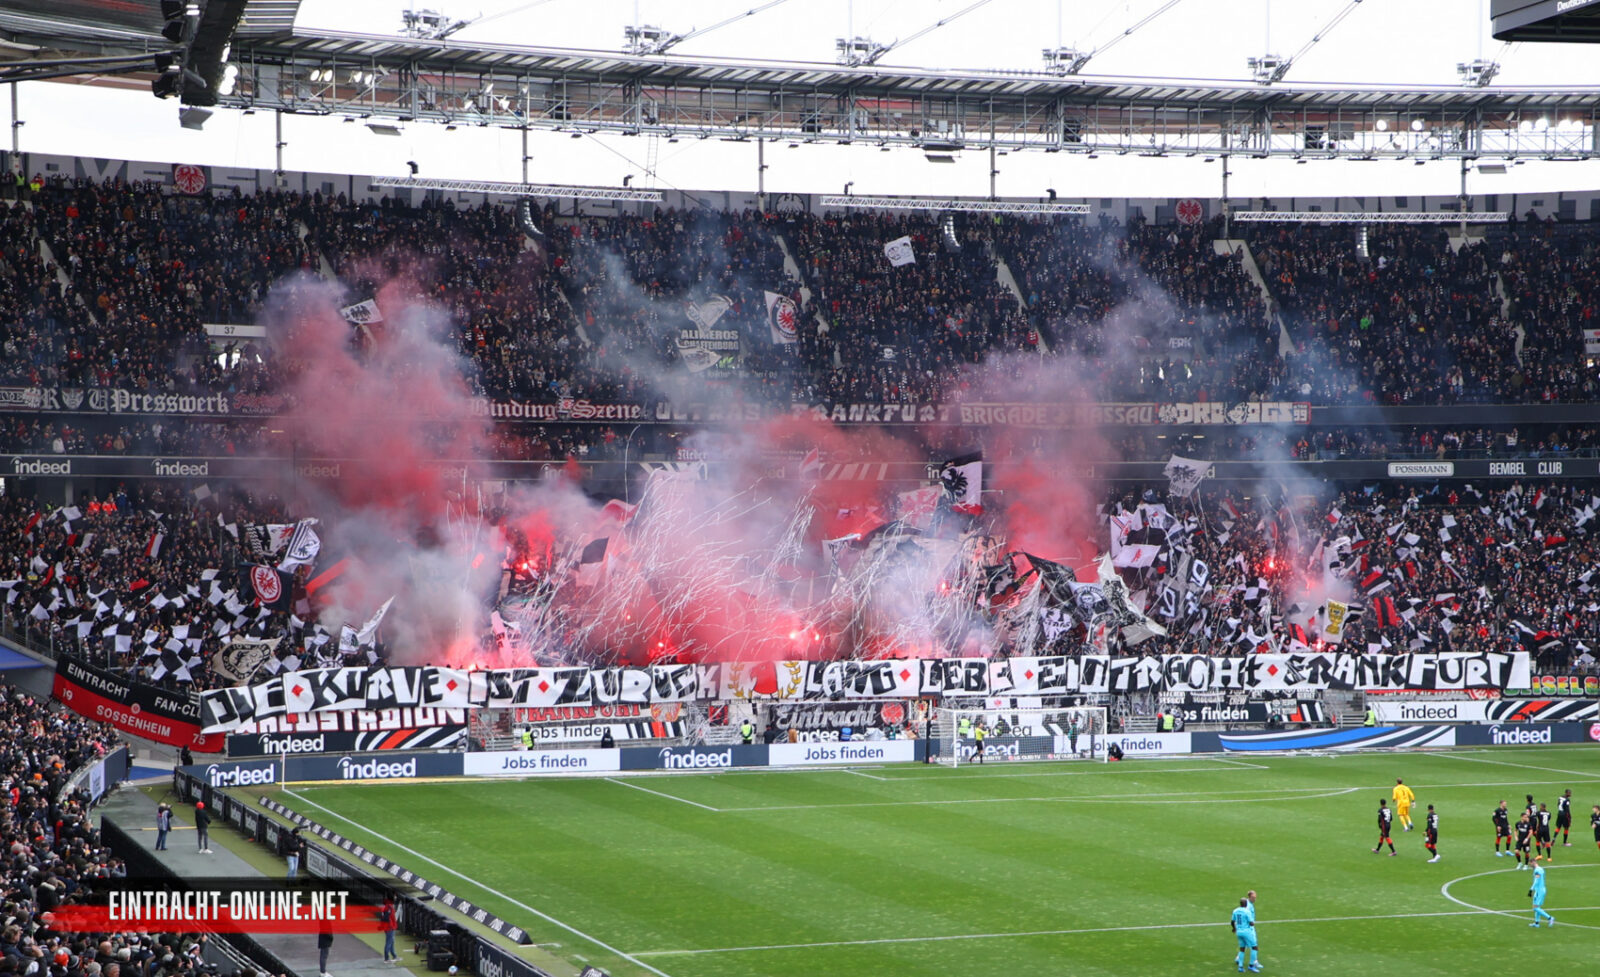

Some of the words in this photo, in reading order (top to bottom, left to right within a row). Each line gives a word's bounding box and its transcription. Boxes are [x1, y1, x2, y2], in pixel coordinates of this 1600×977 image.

[224, 326, 235, 335] 37
[110, 388, 230, 413] Presswerk
[571, 399, 641, 419] Szene
[791, 403, 951, 422] FRANKFURT
[960, 406, 1047, 424] BRIGADE
[14, 458, 71, 475] indeed
[154, 458, 209, 476] indeed
[296, 464, 341, 478] ndeed
[1395, 465, 1448, 474] POSSMANN
[1490, 462, 1526, 475] BEMBEL
[1538, 461, 1562, 475] CLUB
[67, 663, 131, 699] EINTRACHT
[468, 669, 540, 706] IST
[62, 687, 74, 701] 19
[96, 704, 171, 738] SOSSENHEIM
[192, 733, 206, 745] 75
[776, 703, 877, 730] Eintracht
[1201, 706, 1249, 721] finden
[1400, 704, 1458, 719] indeed
[531, 725, 559, 739] obs
[1492, 725, 1552, 745] indeed
[263, 734, 325, 754] indeed
[1121, 737, 1163, 750] finden
[501, 756, 536, 770] Jobs
[540, 753, 588, 768] finden
[664, 748, 732, 769] indeed
[804, 747, 837, 761] Jobs
[840, 745, 884, 760] finden
[210, 762, 275, 787] indeed
[342, 757, 416, 779] indeed
